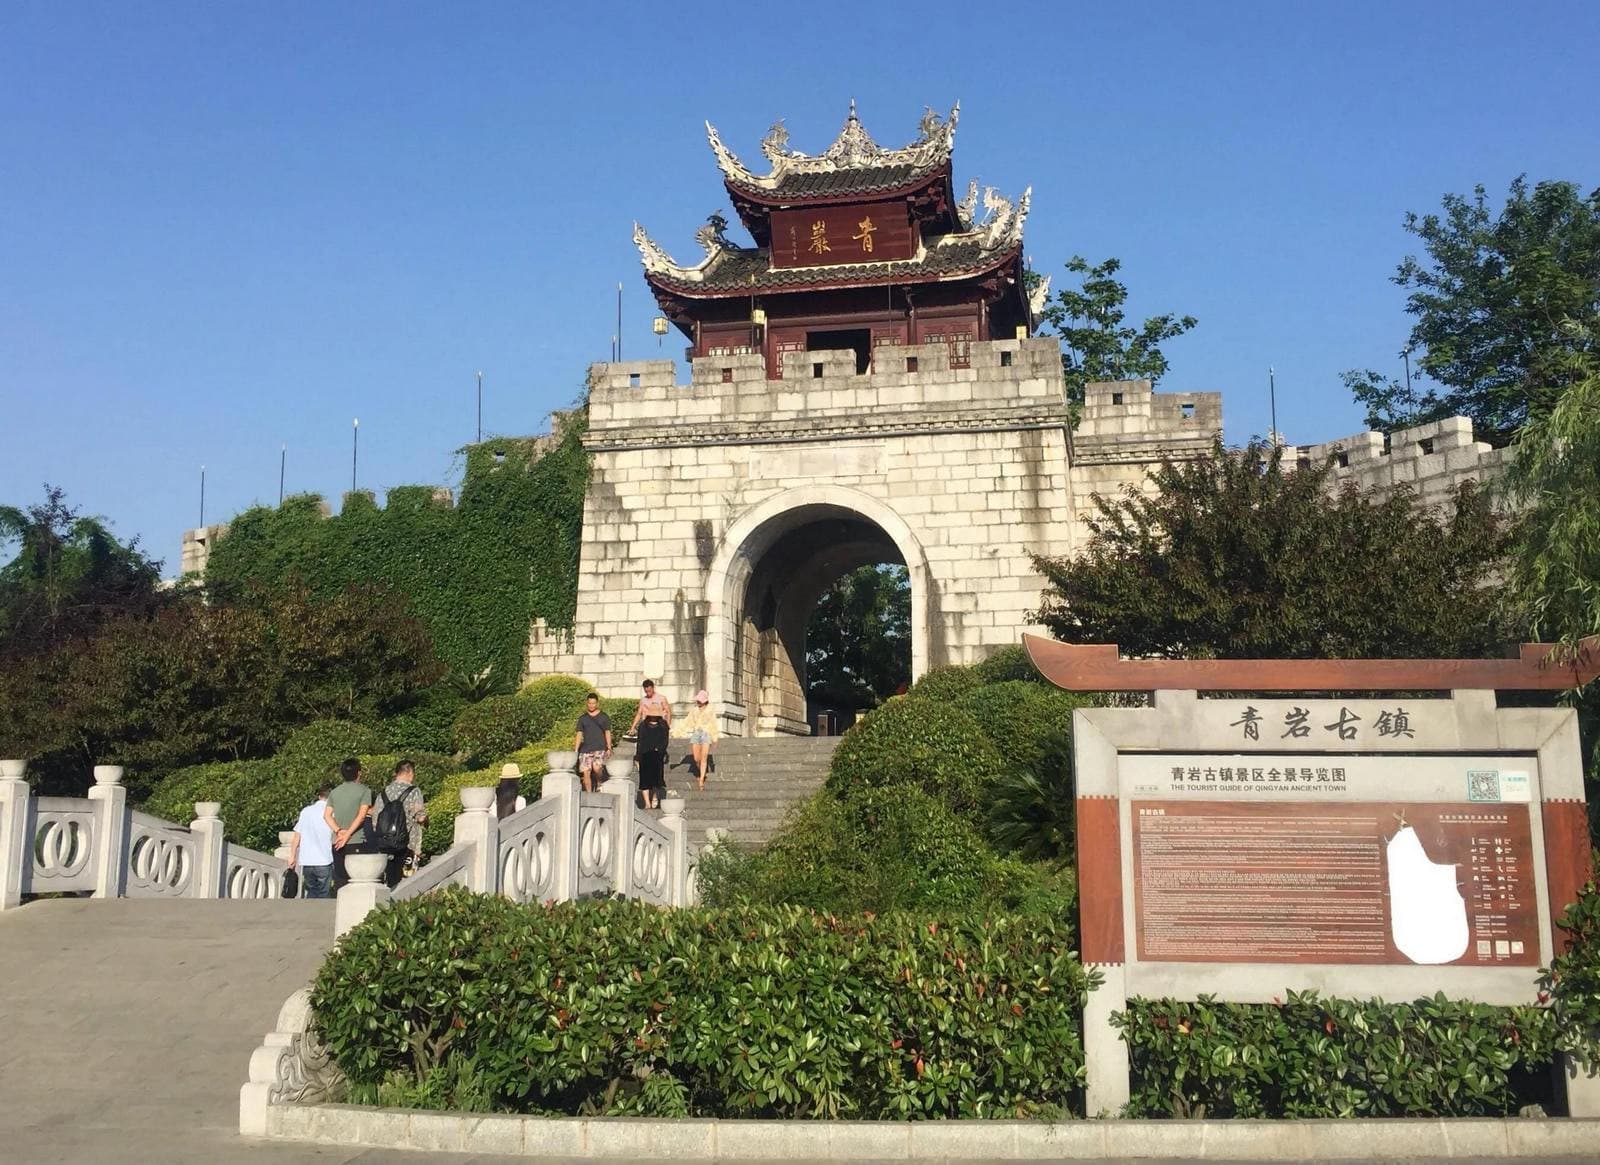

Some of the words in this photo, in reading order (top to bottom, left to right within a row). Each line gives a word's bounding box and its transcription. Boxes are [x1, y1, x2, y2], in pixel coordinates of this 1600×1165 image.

[1230, 705, 1416, 741] 青岩古鎮
[1171, 766, 1347, 782] 青岩古镇景区全景导览图
[1290, 784, 1322, 792] ANCIENT
[1324, 784, 1347, 792] TOWN
